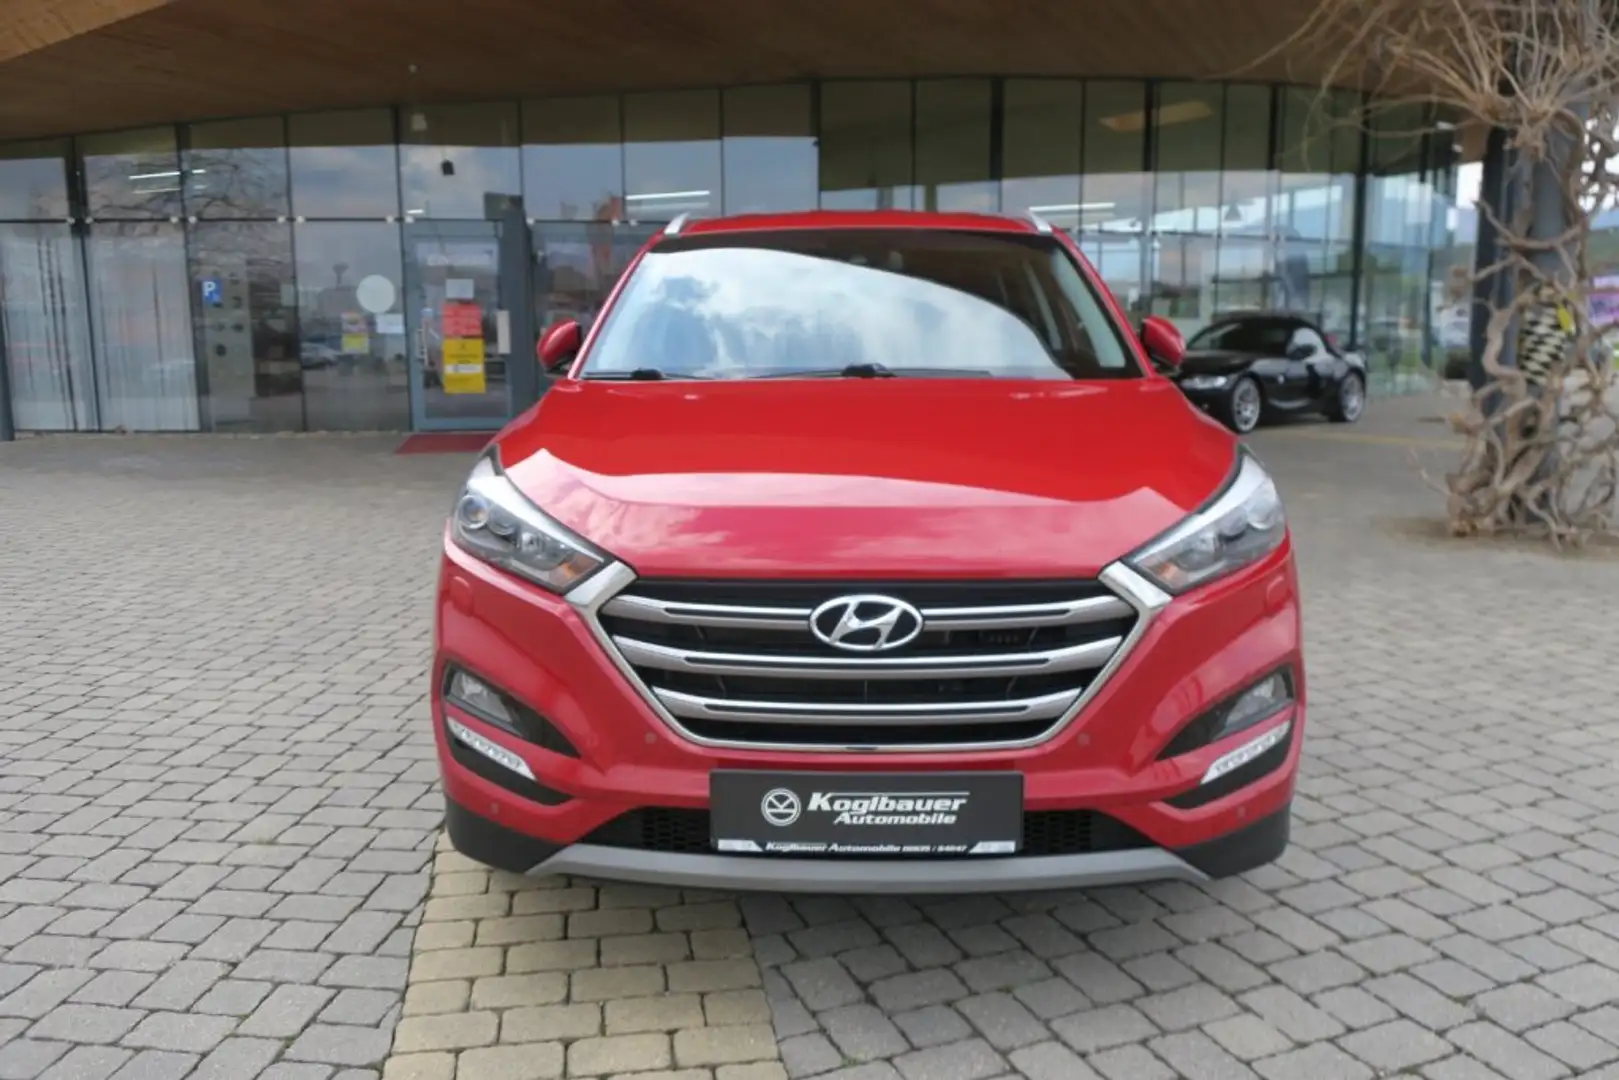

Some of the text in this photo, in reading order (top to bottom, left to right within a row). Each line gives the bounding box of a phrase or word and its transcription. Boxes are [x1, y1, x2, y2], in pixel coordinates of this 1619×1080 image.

[204, 282, 216, 296] P
[808, 792, 967, 814] Koglbauer
[833, 813, 956, 825] Automobile
[766, 842, 827, 853] Koglbauer
[828, 842, 902, 853] Automobile
